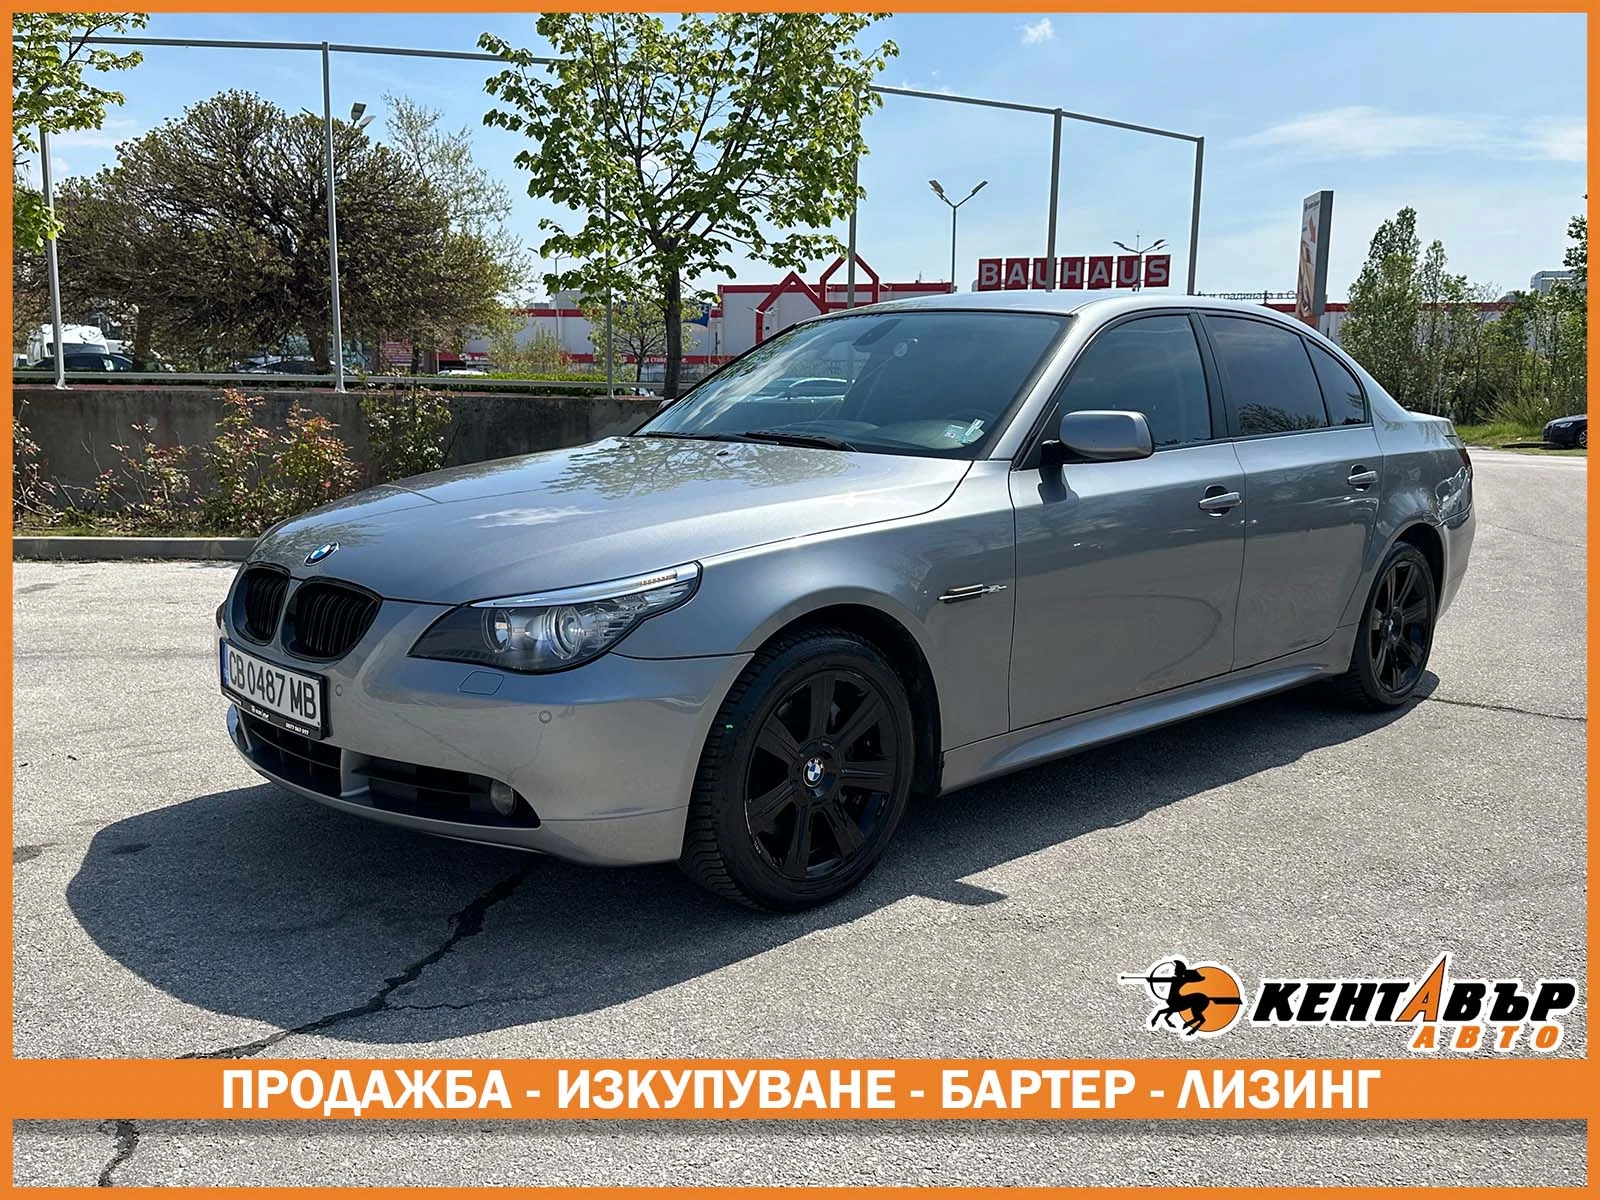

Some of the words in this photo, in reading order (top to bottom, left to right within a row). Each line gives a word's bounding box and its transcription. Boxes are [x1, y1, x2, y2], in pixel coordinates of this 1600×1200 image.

[981, 258, 1168, 286] BAUHAUS
[229, 651, 245, 690] CB
[247, 661, 286, 708] 0487
[290, 677, 317, 720] MB
